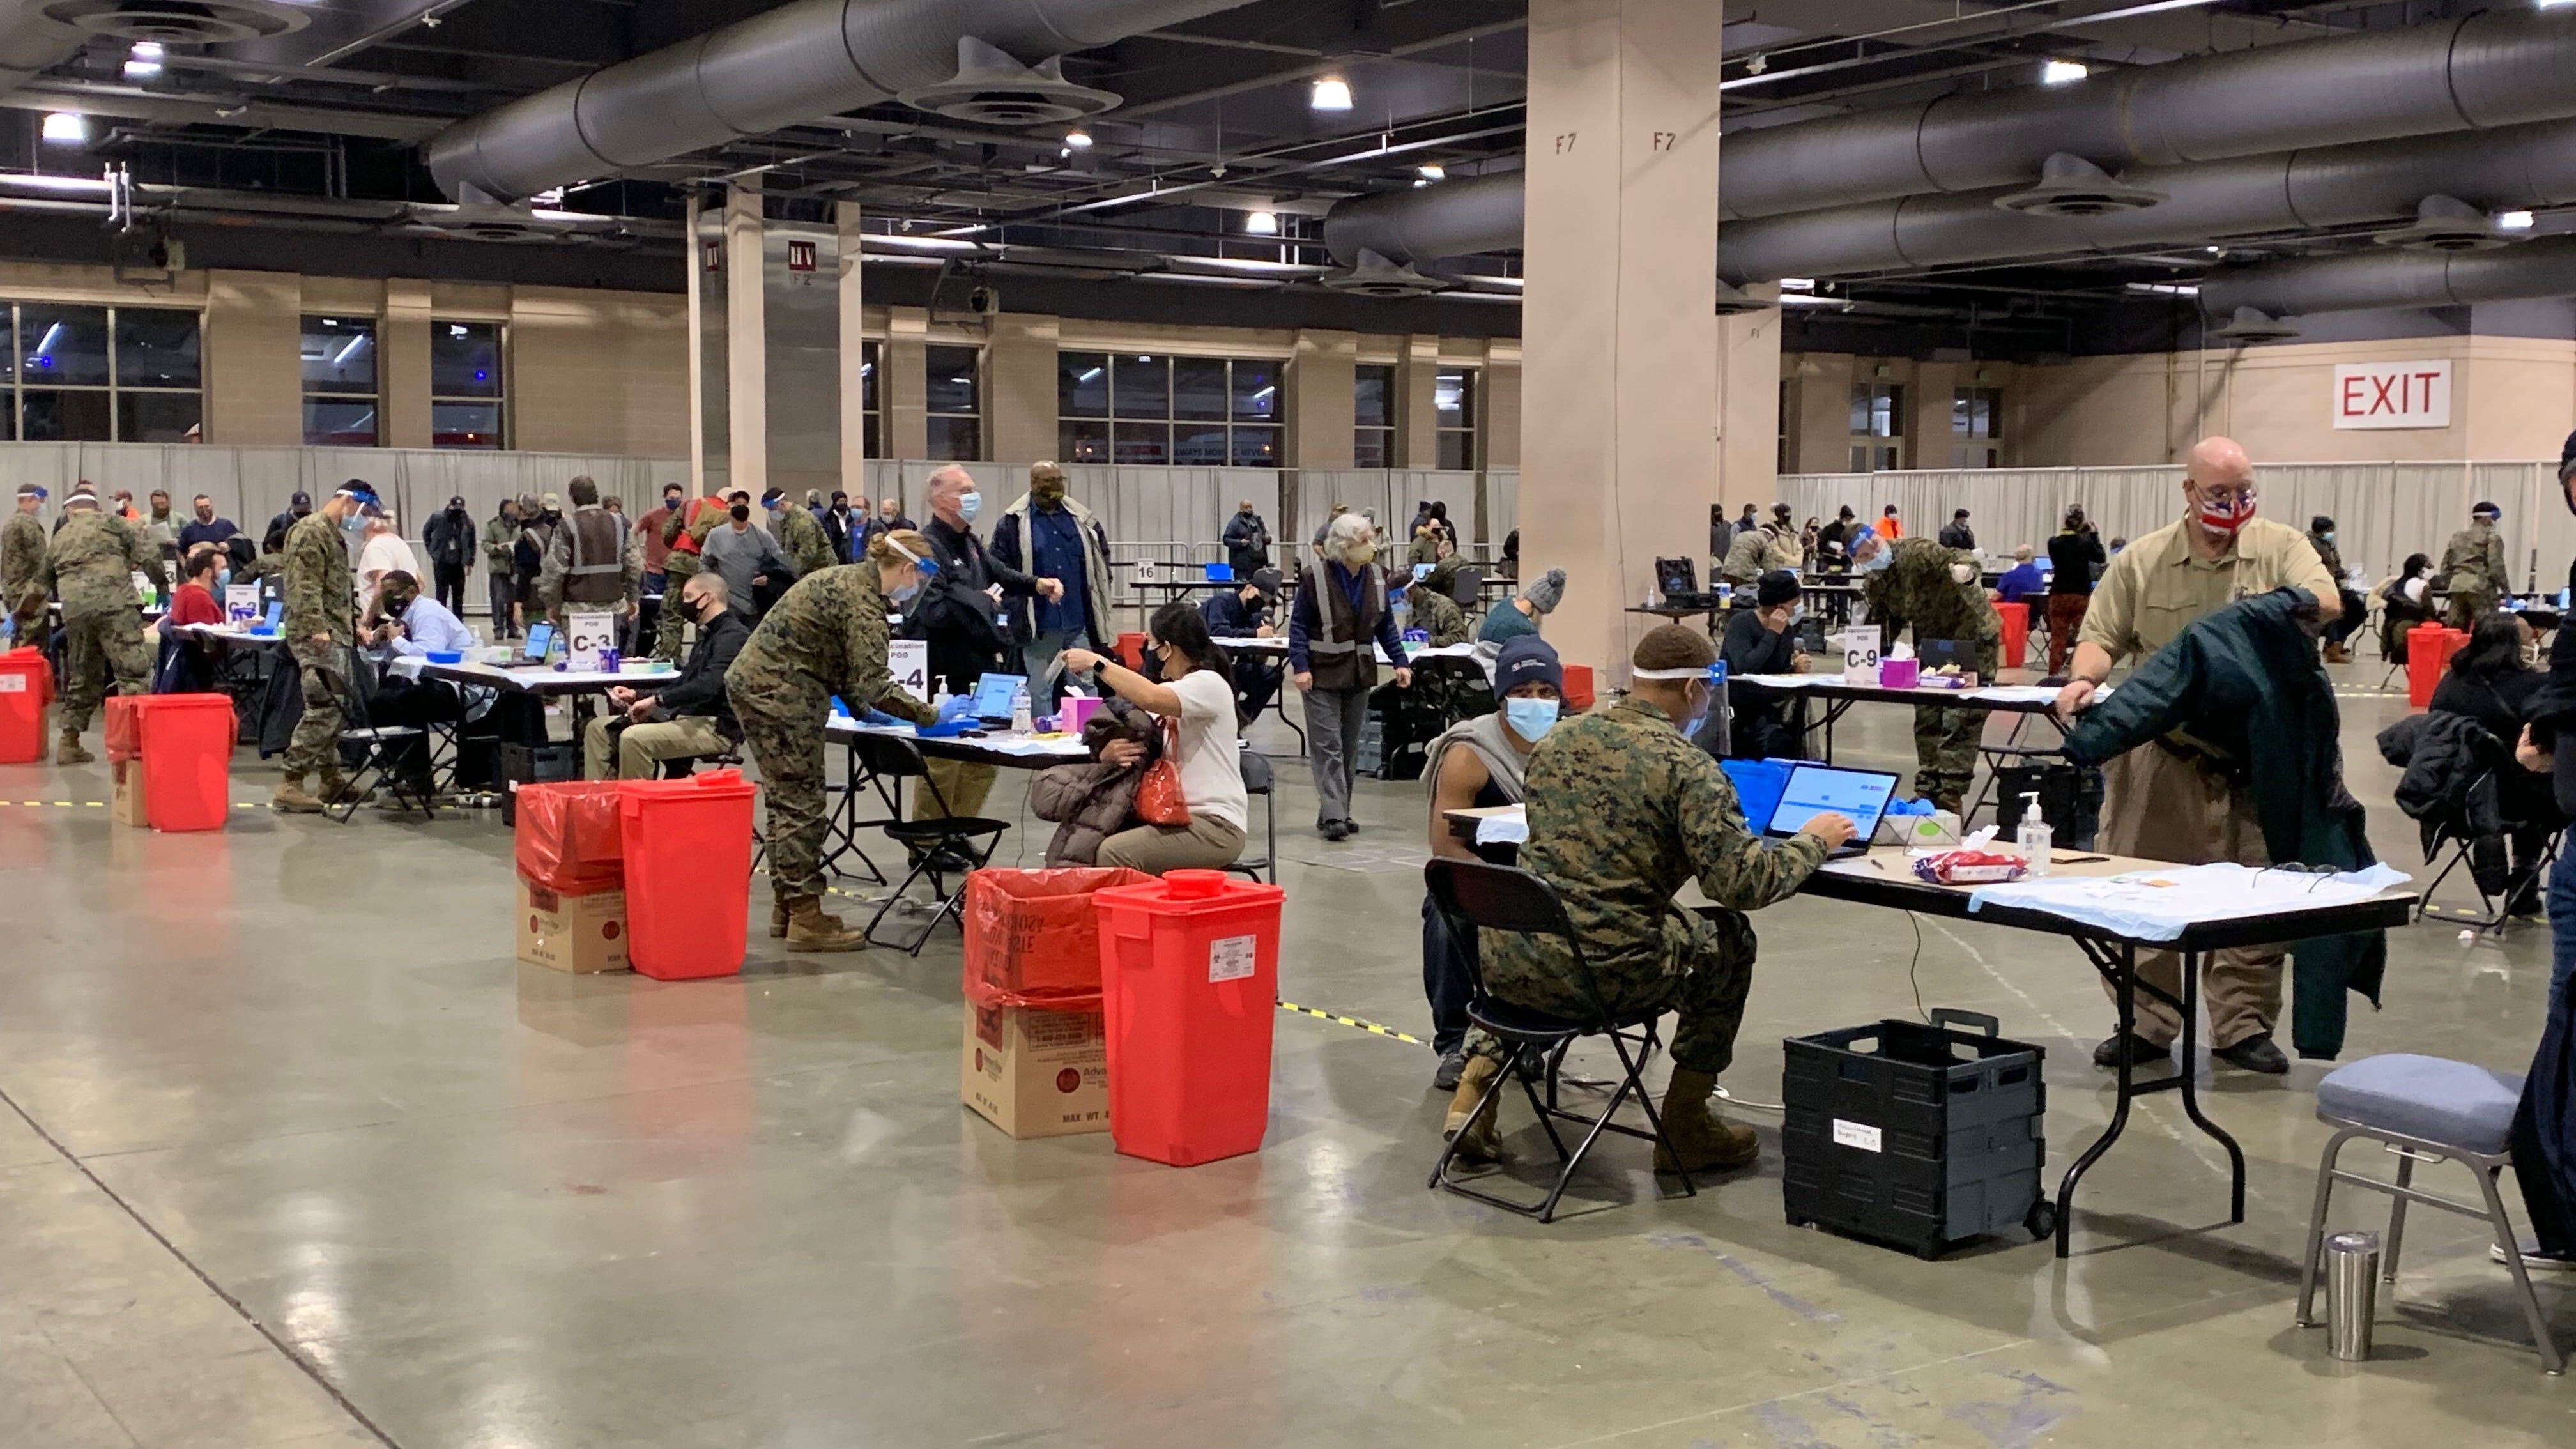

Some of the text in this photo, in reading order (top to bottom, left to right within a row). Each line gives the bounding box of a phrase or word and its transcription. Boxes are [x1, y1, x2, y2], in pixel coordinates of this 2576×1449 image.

[1556, 133, 1576, 155] F7
[1654, 132, 1676, 151] F7
[2343, 372, 2440, 416] EXIT
[1138, 566, 1153, 578] 16
[574, 634, 610, 652] C-3
[1848, 649, 1877, 668] C-9
[897, 668, 924, 689] -4
